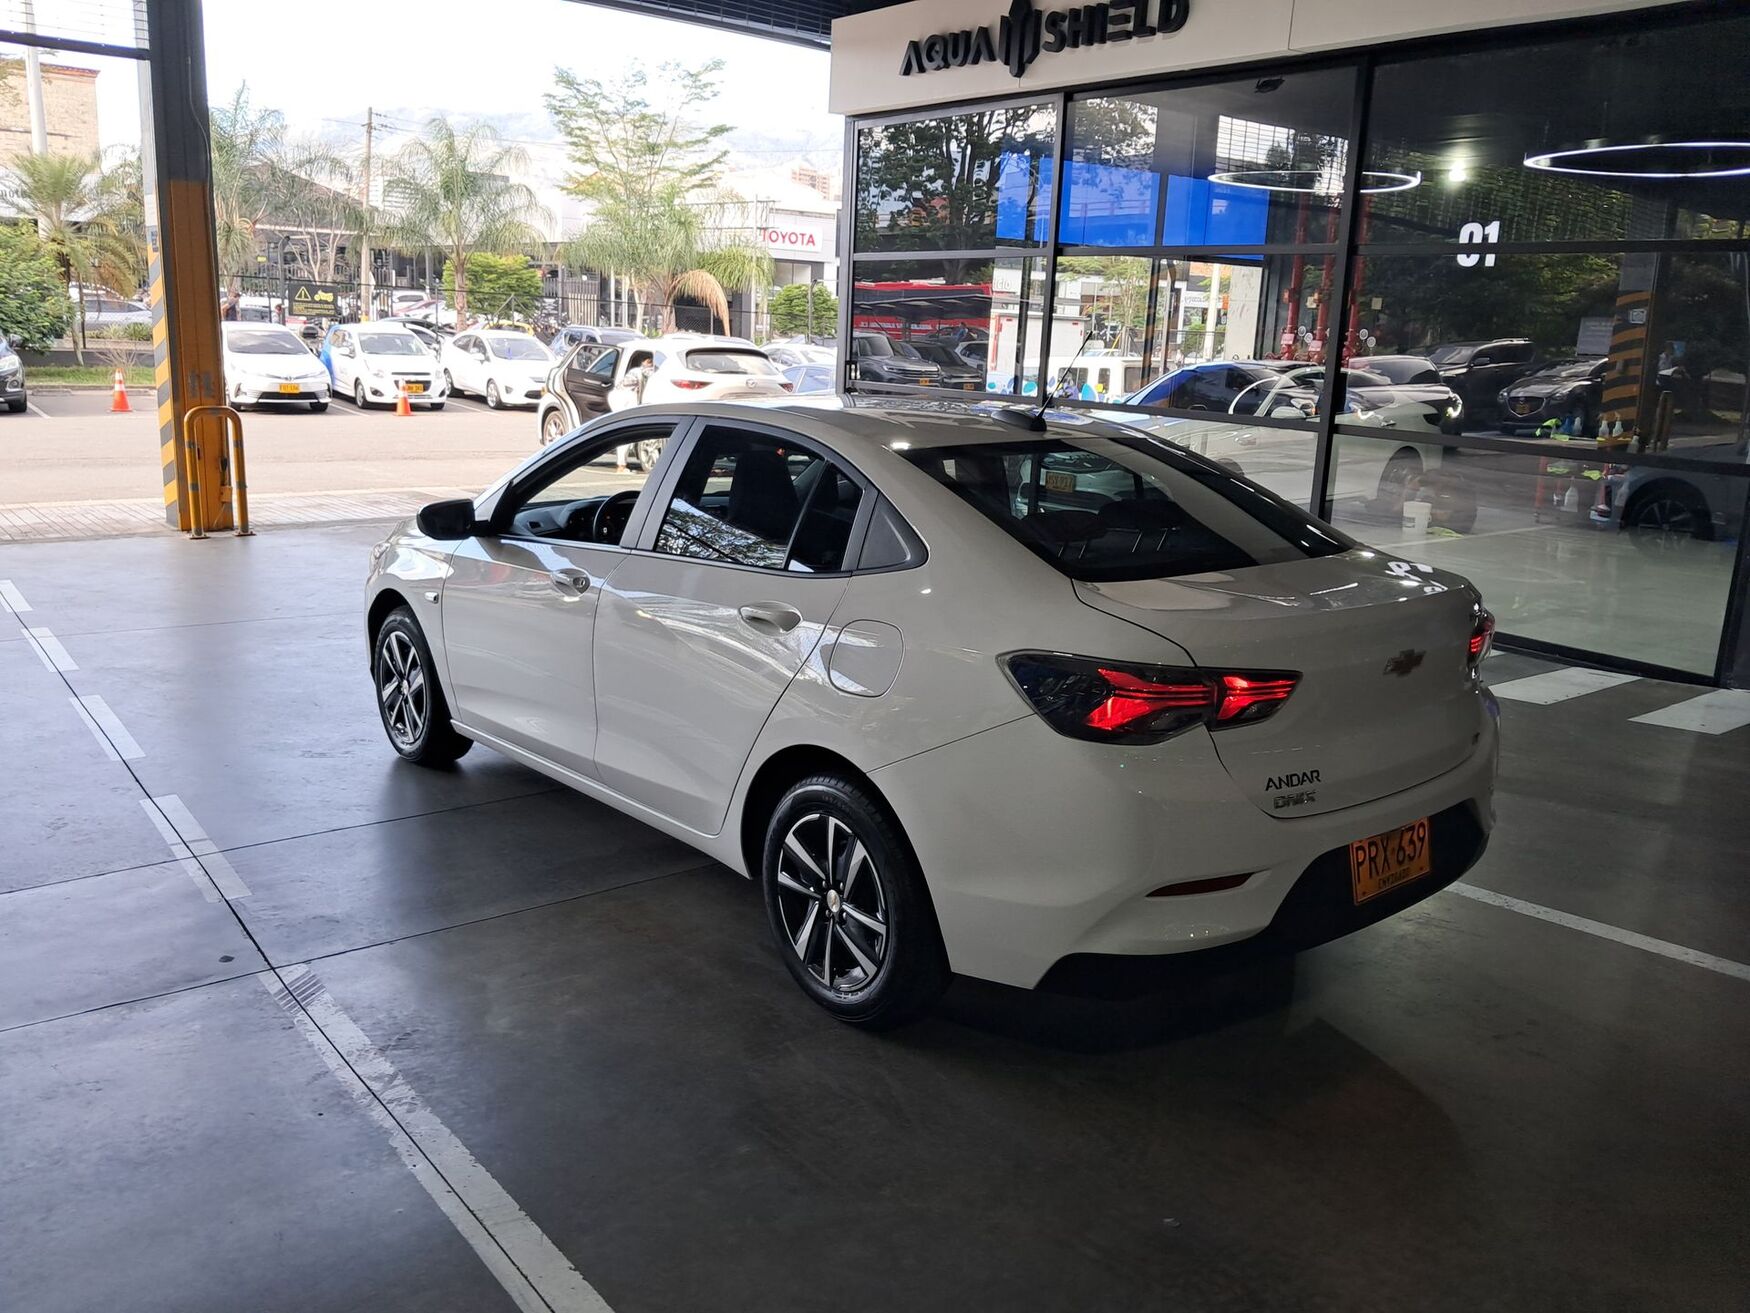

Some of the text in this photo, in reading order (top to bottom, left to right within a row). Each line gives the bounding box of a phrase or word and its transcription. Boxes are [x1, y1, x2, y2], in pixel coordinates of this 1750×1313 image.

[899, 0, 1190, 76] AQUA SHIELD
[761, 228, 816, 246] TOYOTA
[1457, 220, 1500, 267] 01
[1265, 769, 1321, 791] ANDAR
[1355, 821, 1426, 884] PRX 639
